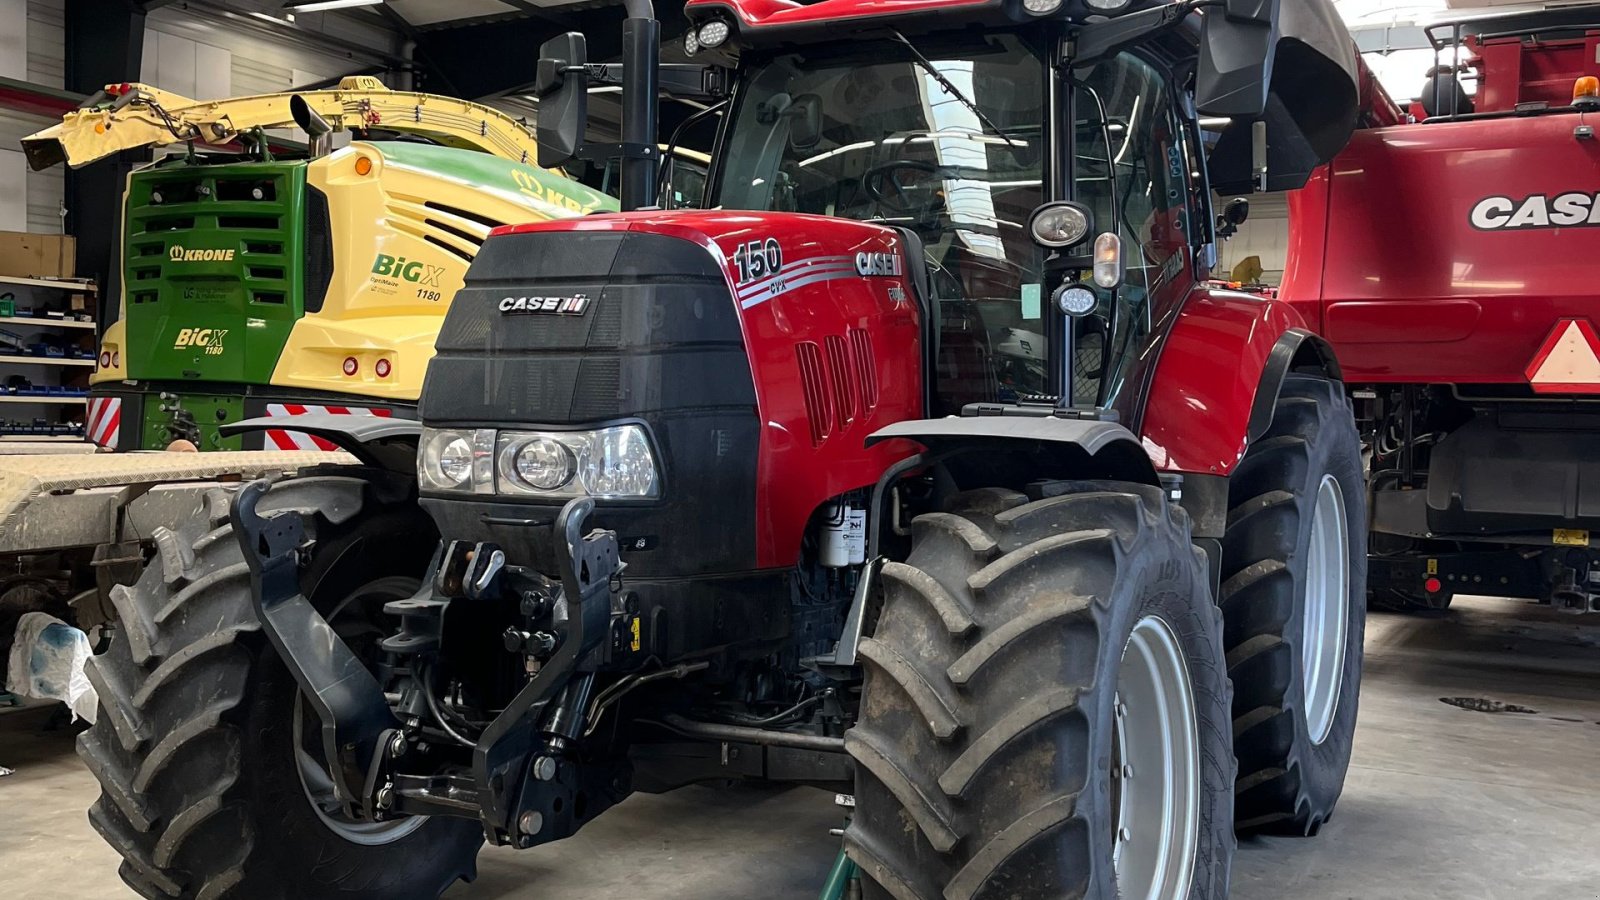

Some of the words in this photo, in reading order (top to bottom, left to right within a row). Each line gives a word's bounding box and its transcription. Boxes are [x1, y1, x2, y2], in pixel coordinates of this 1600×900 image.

[184, 249, 235, 261] KRONE
[733, 237, 783, 285] 150
[855, 251, 892, 276] CASE
[416, 288, 441, 302] 1180
[770, 280, 787, 295] CVX
[499, 296, 560, 311] CASE
[204, 346, 223, 355] 1180
